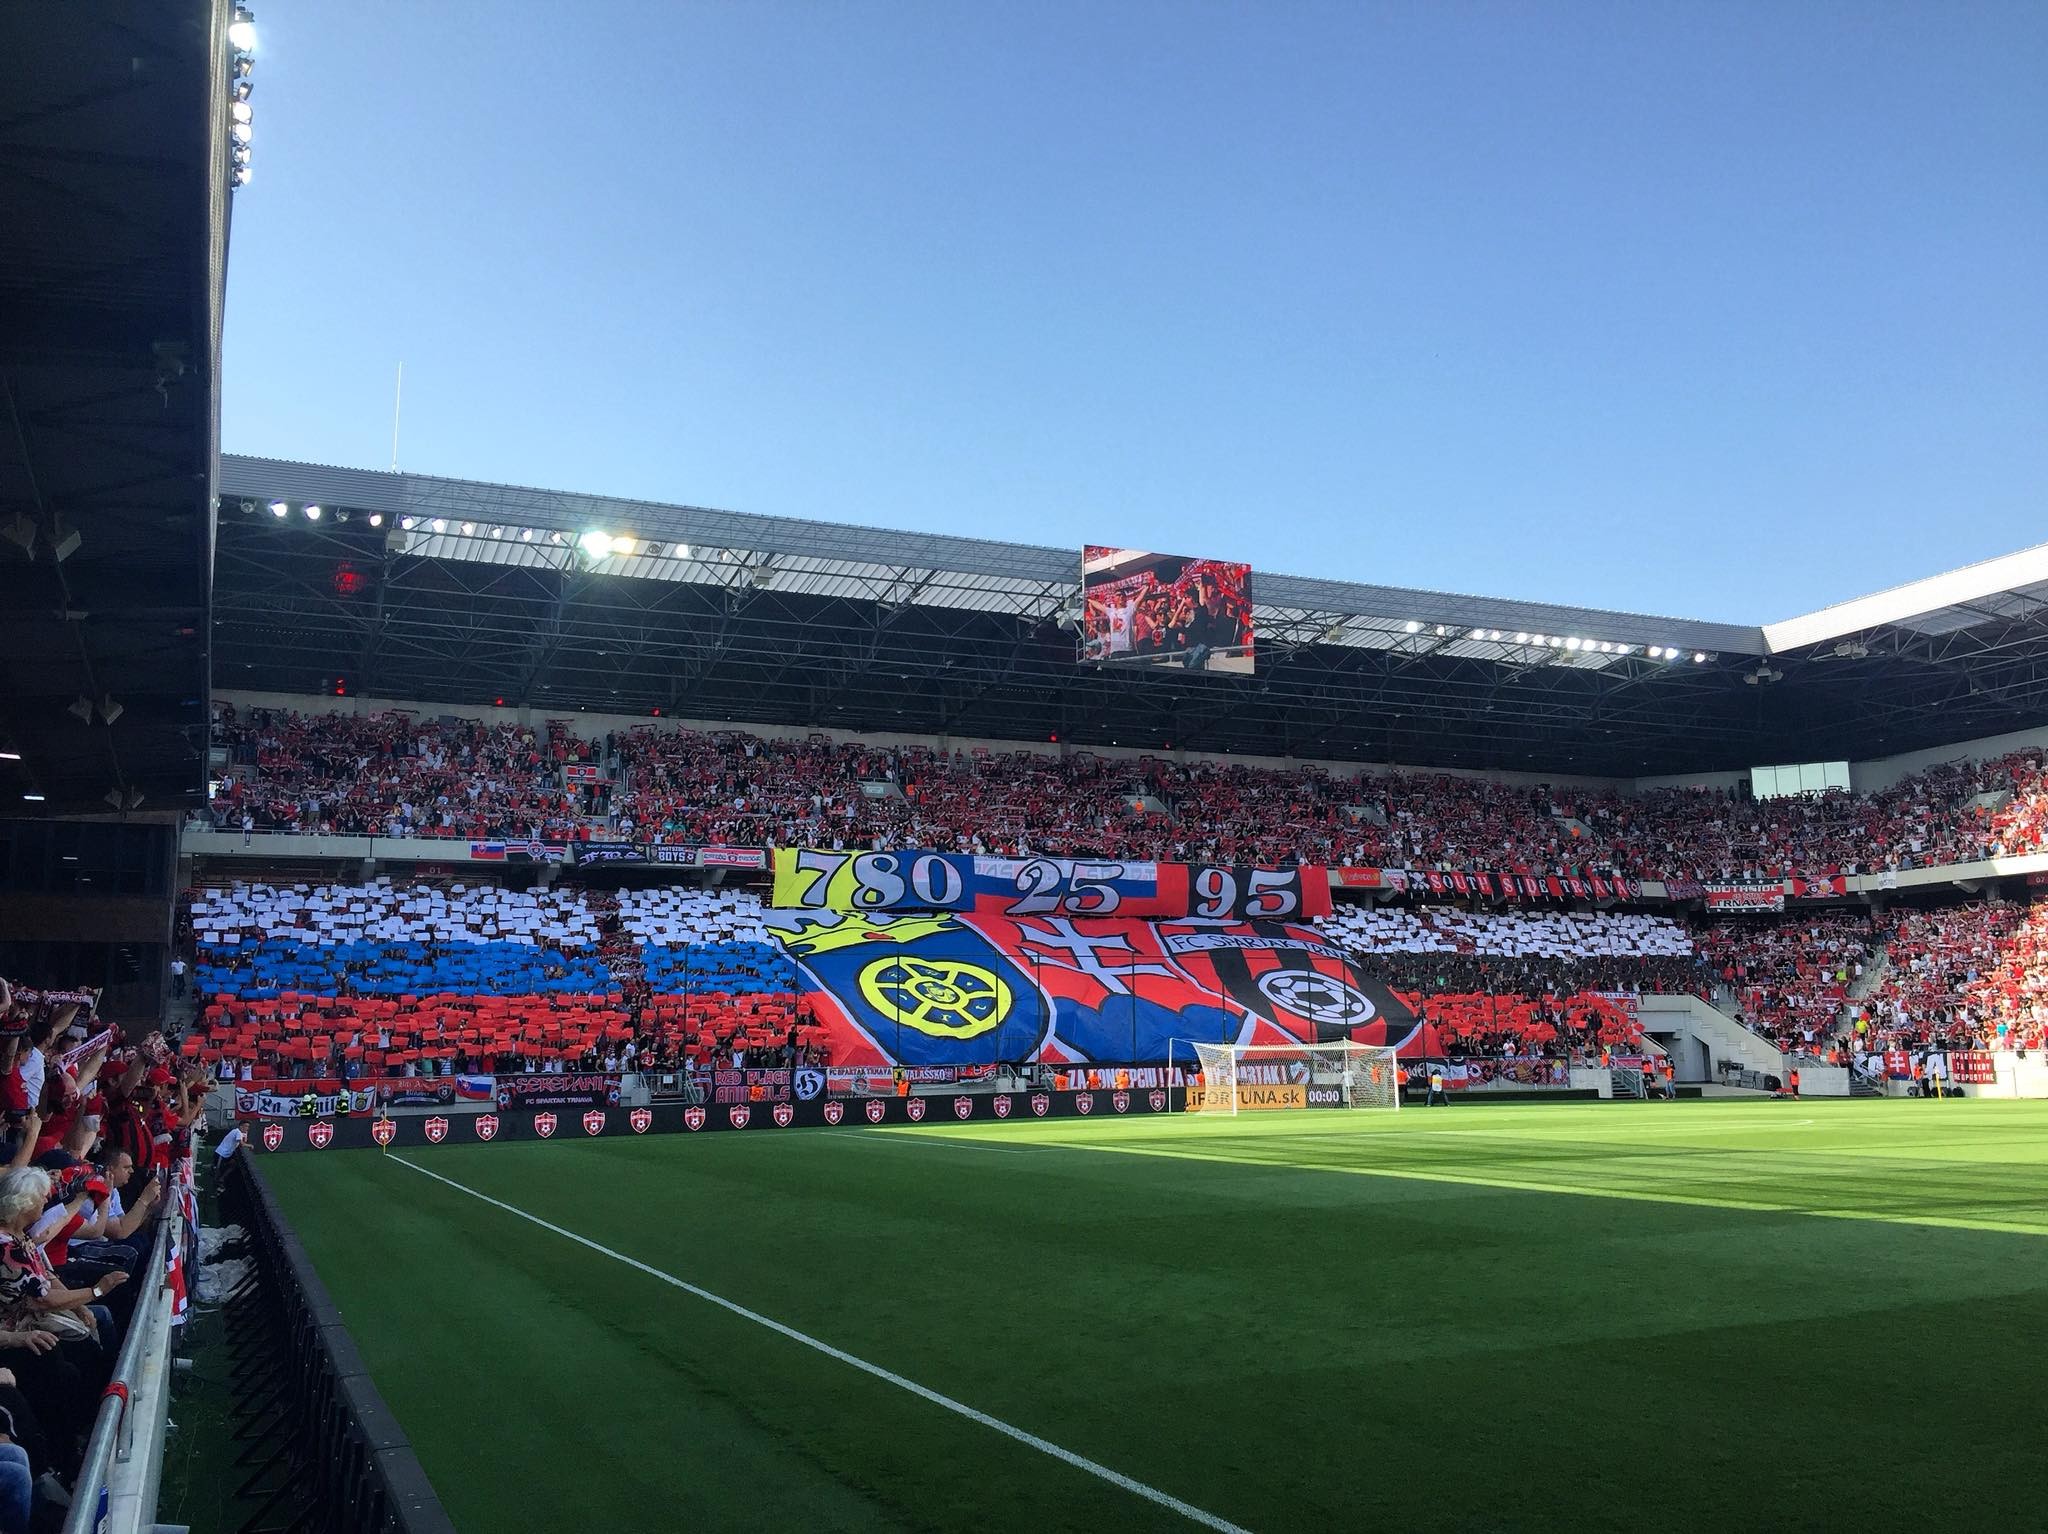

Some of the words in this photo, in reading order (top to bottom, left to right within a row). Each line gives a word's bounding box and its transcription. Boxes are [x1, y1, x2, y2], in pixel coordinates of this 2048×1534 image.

[659, 852, 685, 862] BOYS
[795, 850, 962, 909] 780
[1004, 858, 1124, 915] 25
[1430, 874, 1492, 894] SOUTH
[1502, 877, 1548, 894] SIDE
[1559, 878, 1627, 895] TRNAVA
[1195, 867, 1297, 918] 95
[1704, 884, 1778, 893] SOUTHSIDE
[1717, 899, 1768, 907] TRNAVA
[1173, 937, 1204, 950] FC
[1209, 935, 1295, 949] SPARTAK
[1952, 1052, 1981, 1060] SPARTAK
[715, 1071, 742, 1085] RED
[747, 1070, 791, 1085] BLACK
[1068, 1069, 1087, 1089] ZA
[1087, 1068, 1157, 1089] ONPCIU
[1166, 1067, 1185, 1087] ZA
[1308, 1090, 1340, 1103] 00:00
[260, 1098, 281, 1113] La
